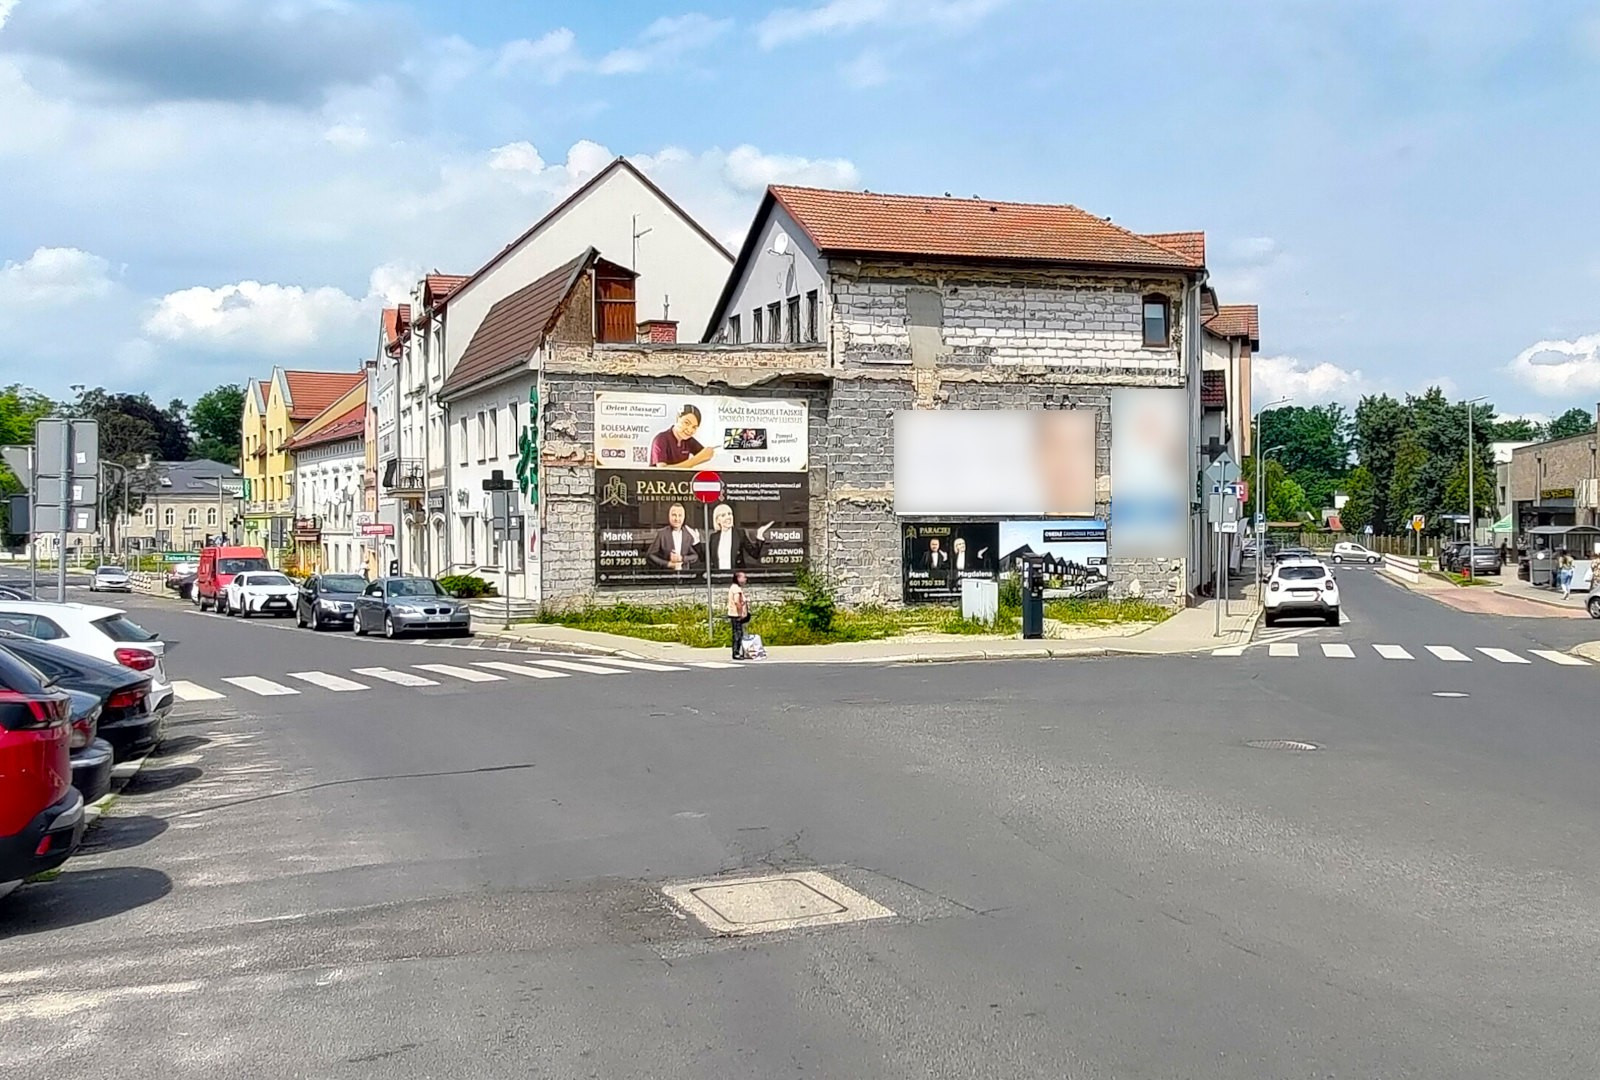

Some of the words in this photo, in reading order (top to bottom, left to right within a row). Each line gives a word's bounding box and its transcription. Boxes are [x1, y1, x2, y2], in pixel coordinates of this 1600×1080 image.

[630, 405, 661, 414] Massage
[718, 407, 744, 415] MASAŻE
[601, 424, 650, 432] BOLESŁAWIEC
[603, 532, 633, 540] Marek
[770, 532, 800, 540] Magda
